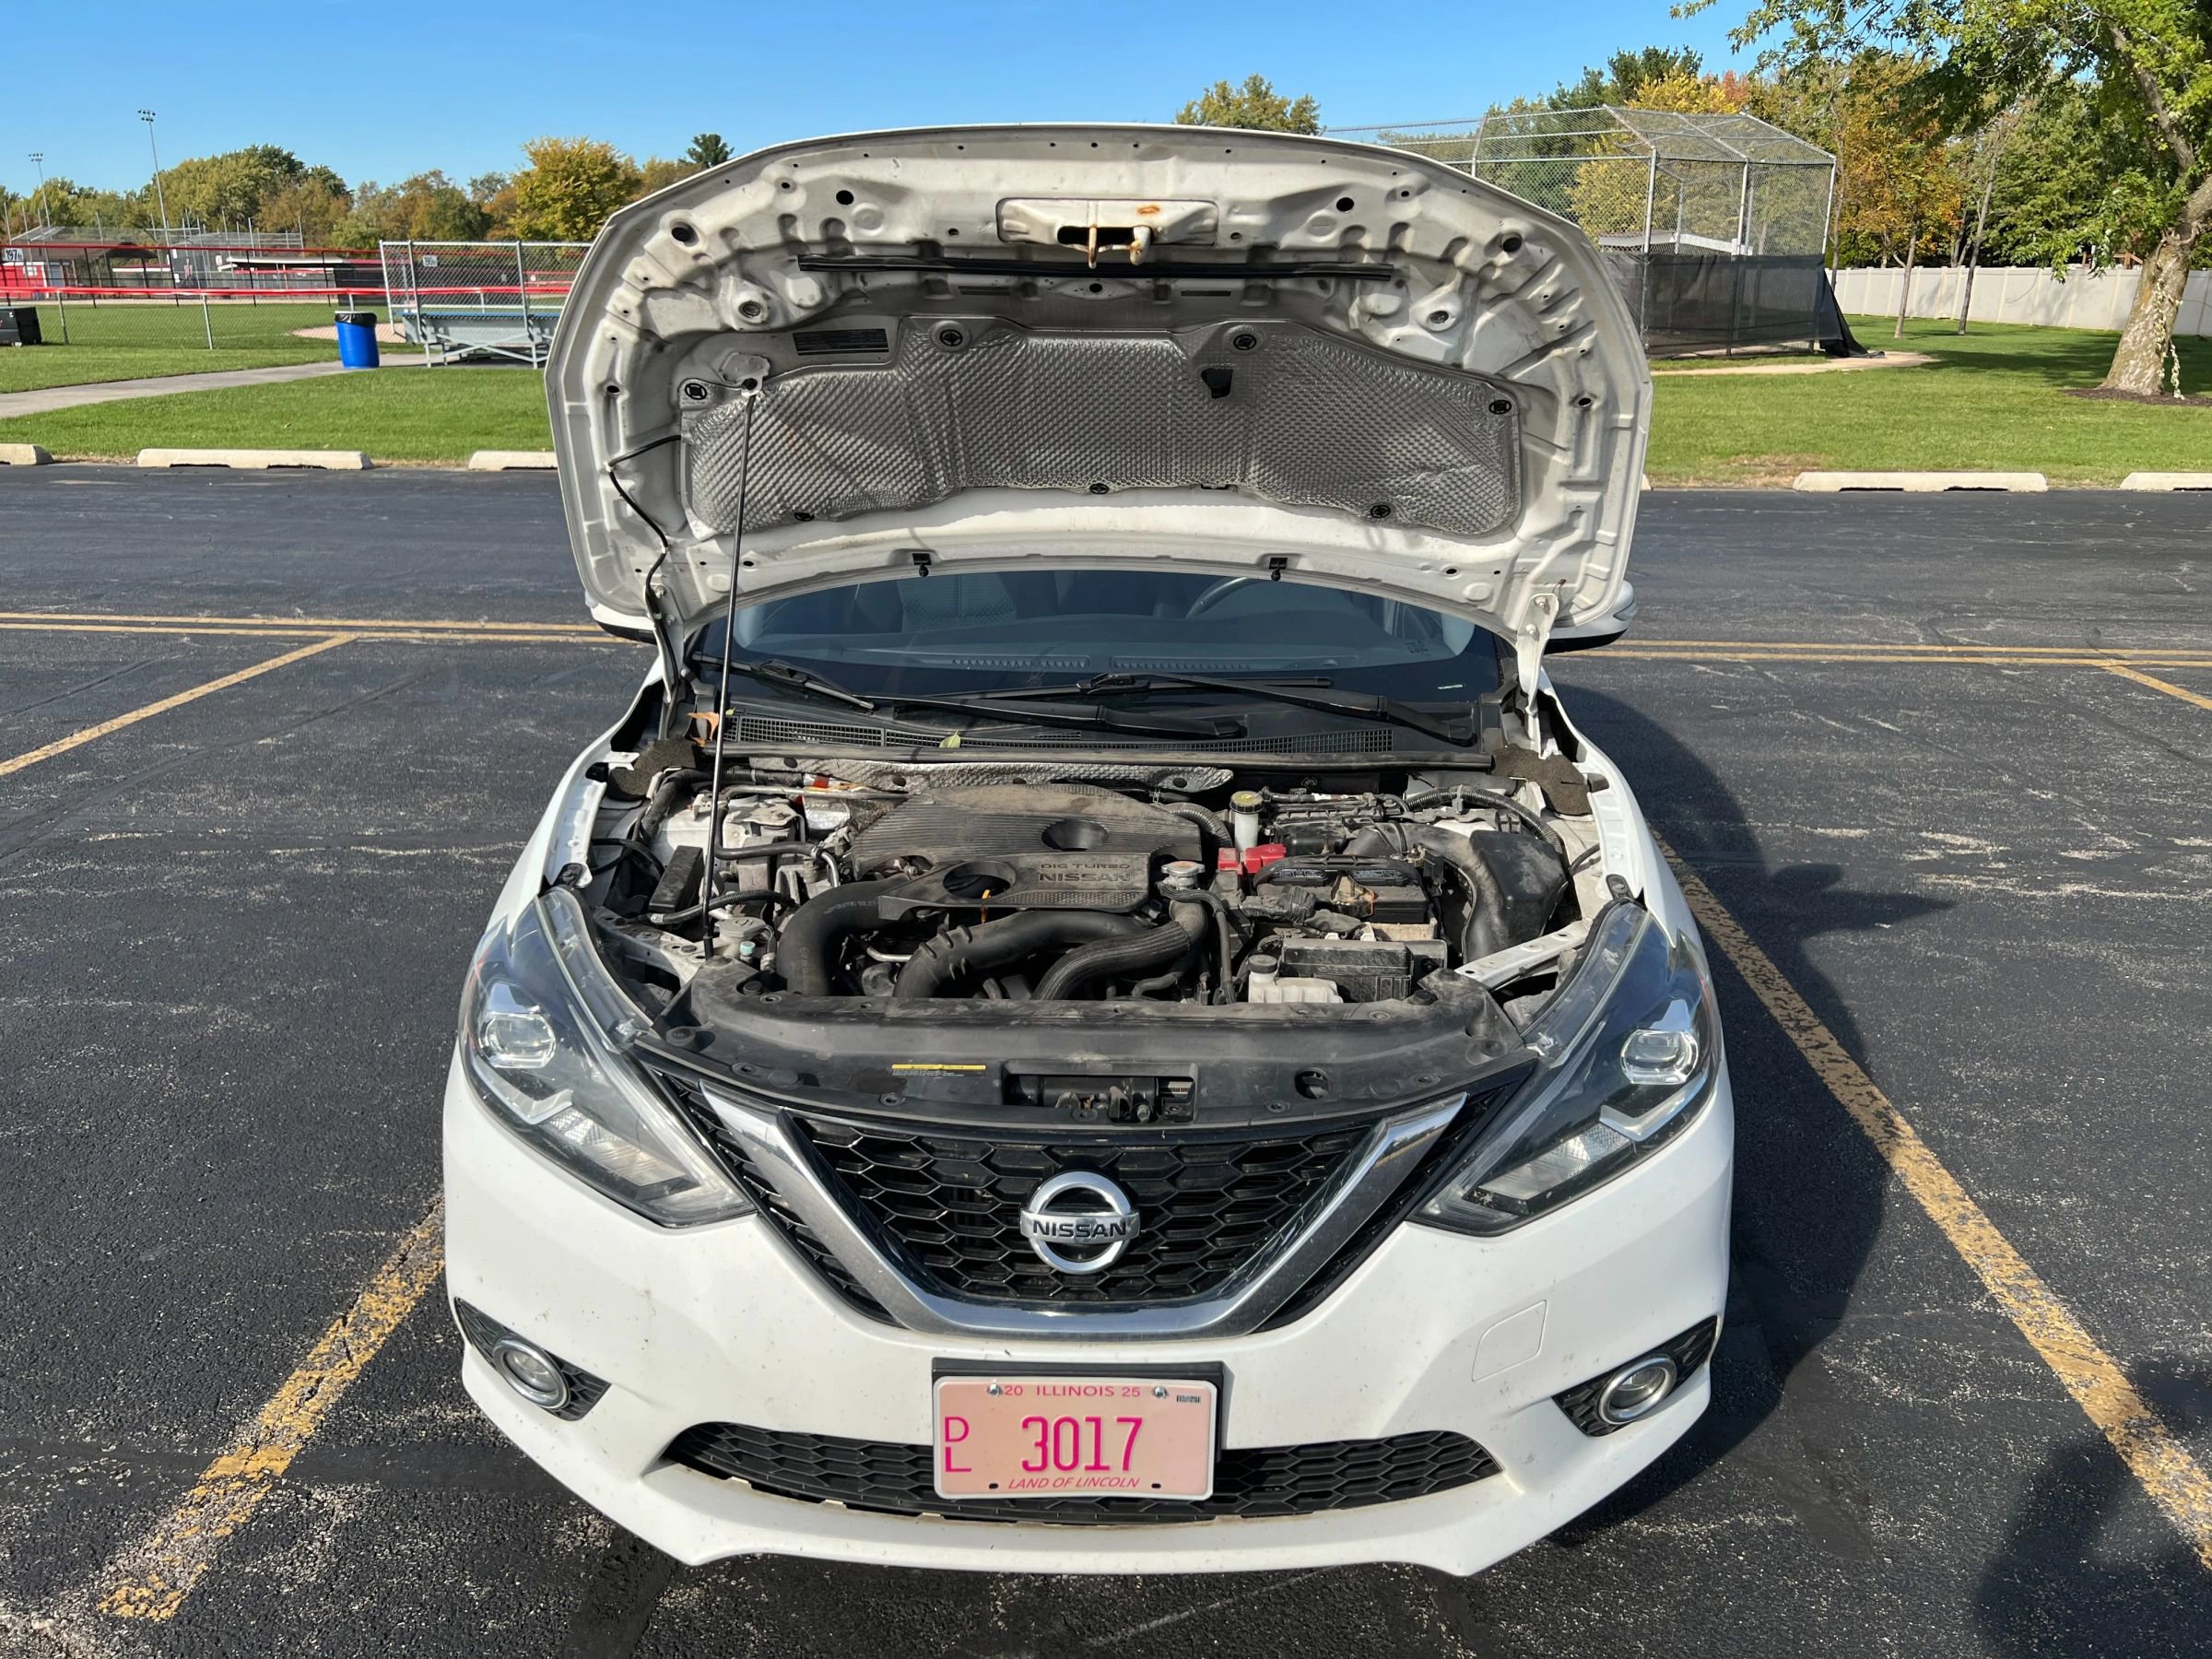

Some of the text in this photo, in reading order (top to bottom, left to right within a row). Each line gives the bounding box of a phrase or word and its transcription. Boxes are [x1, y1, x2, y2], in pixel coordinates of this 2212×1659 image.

[1039, 873, 1131, 882] NISSAN
[1033, 1220, 1126, 1238] NISSAN
[1005, 1385, 1141, 1397] 20 ILLINOIS 25
[1021, 1416, 1144, 1472] 3017
[1008, 1477, 1140, 1489] LAND OF LINCOLN
